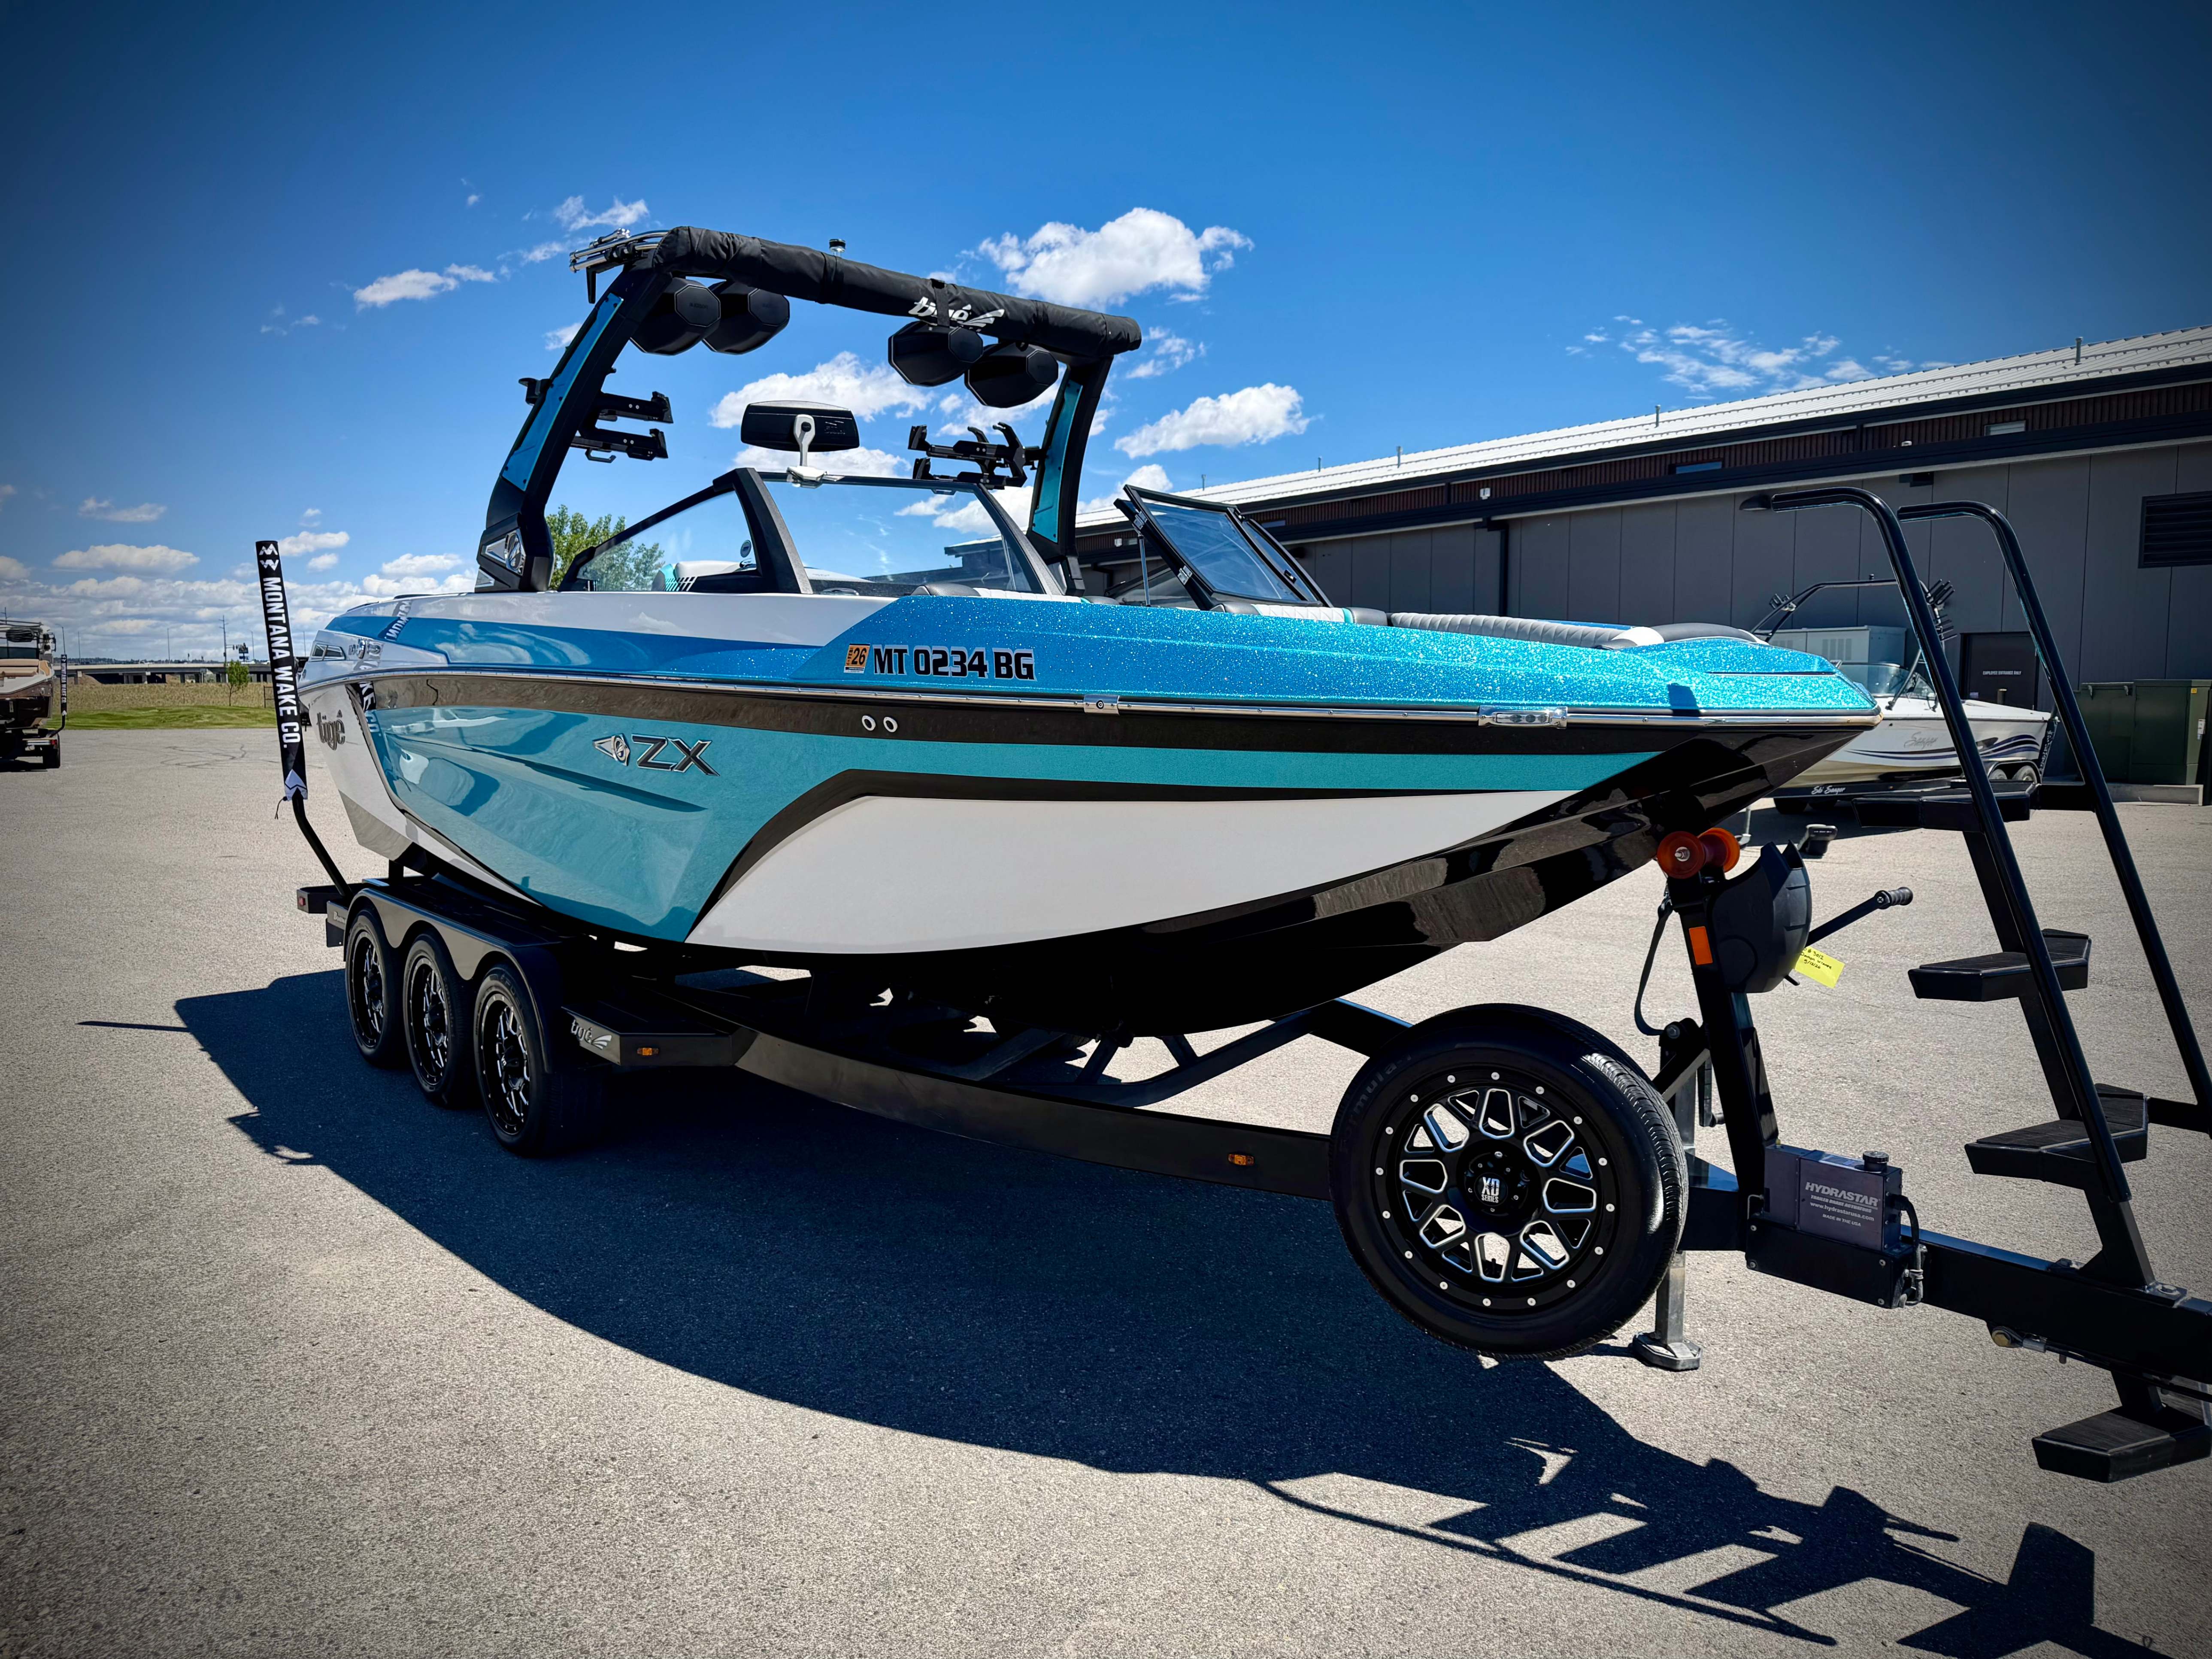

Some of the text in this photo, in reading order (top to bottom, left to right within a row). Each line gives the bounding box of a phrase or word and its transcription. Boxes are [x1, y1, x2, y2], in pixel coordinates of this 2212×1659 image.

[908, 297, 972, 322] tié
[263, 577, 300, 748] MONTANA WAKE CO.
[851, 647, 867, 665] 26
[873, 647, 1036, 680] MT 0234 BG
[631, 733, 720, 776] ZX
[1813, 951, 1824, 960] 3012
[1482, 1177, 1500, 1196] XD
[1805, 1182, 1879, 1207] HYDRASTAR
[1481, 1194, 1499, 1203] SERIES
[1811, 1195, 1829, 1203] TRAILER
[1844, 1203, 1872, 1213] ACTUATORS
[1810, 1202, 1875, 1222] www.hydrastarusa.com
